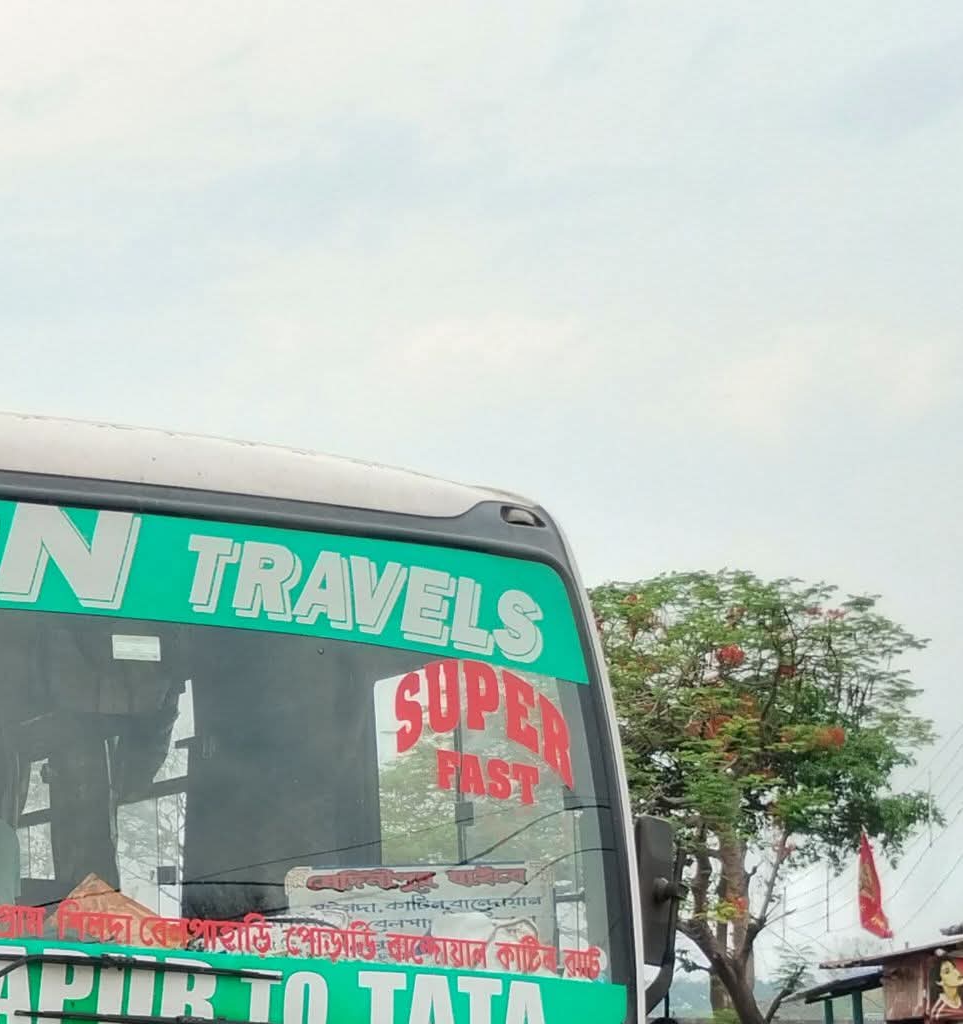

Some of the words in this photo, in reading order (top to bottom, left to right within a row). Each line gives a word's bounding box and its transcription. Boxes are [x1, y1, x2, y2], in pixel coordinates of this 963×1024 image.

[187, 533, 544, 663] TRAVELS
[394, 658, 574, 792] SUPER
[436, 748, 540, 805] FAST
